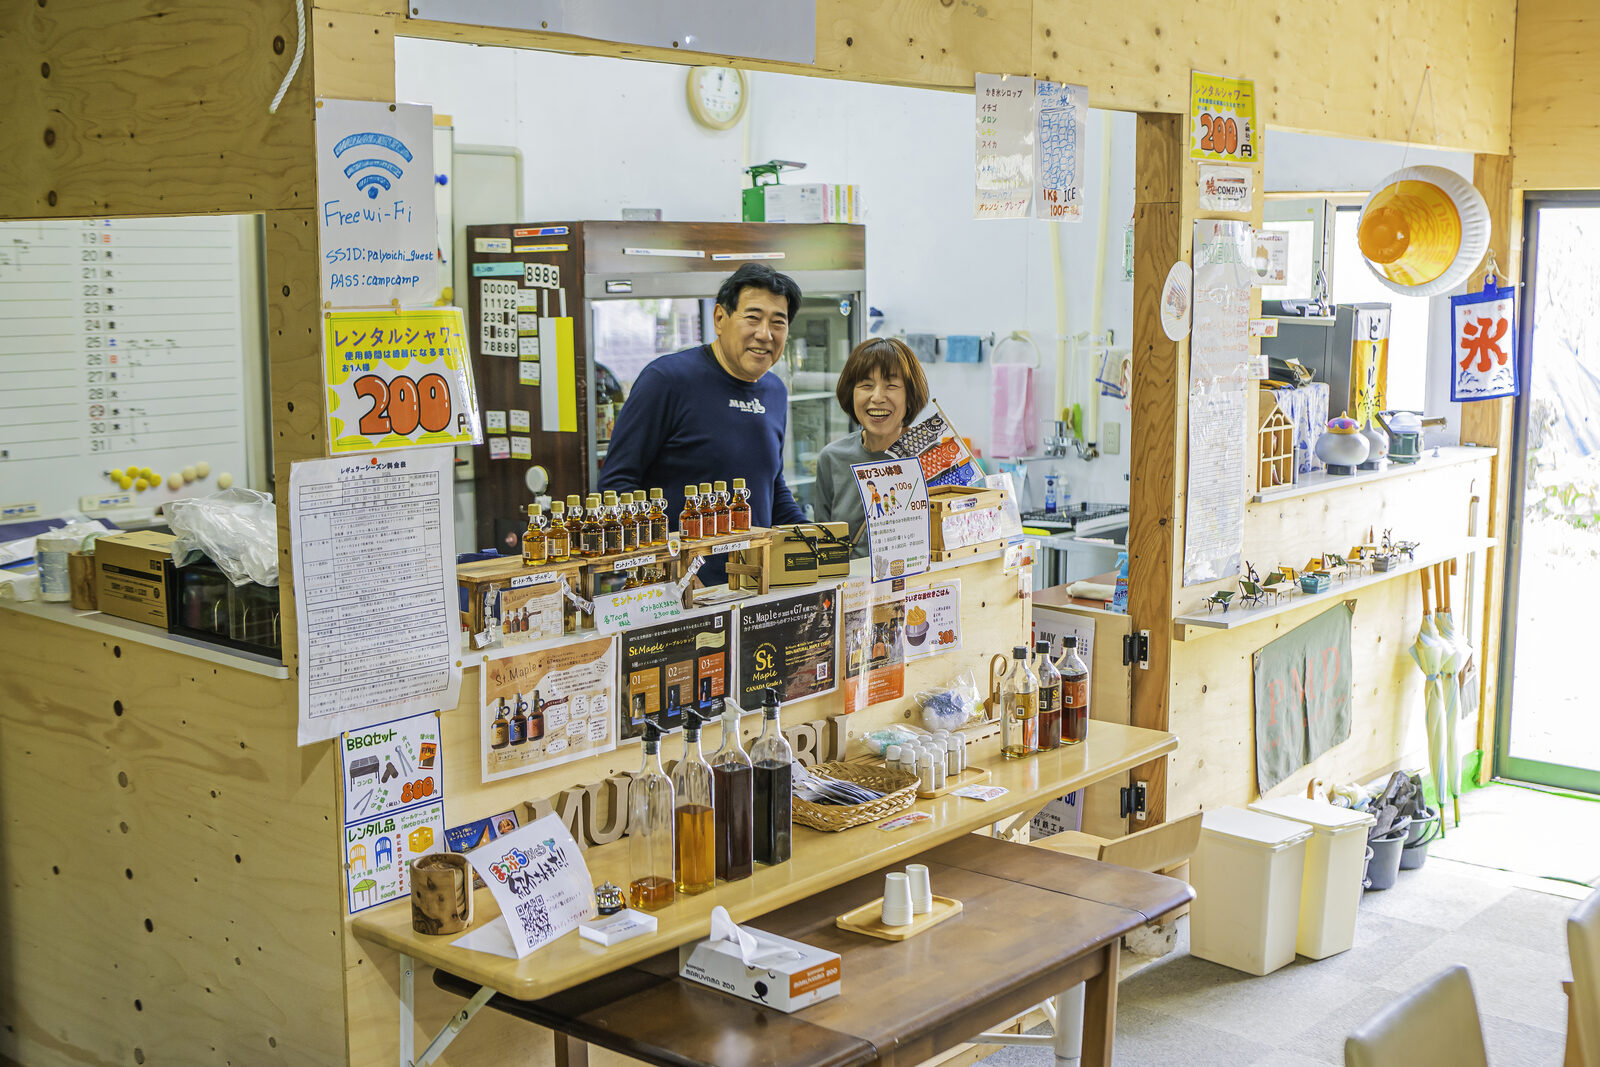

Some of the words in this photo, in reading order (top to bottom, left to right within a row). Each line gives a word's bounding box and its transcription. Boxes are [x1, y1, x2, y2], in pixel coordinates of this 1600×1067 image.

[985, 88, 1023, 98] かき氷シロップ
[981, 103, 998, 112] イチゴ
[981, 115, 997, 124] メロン
[981, 128, 998, 137] レモン
[981, 140, 998, 149] スイカ
[1063, 186, 1076, 203] ICE
[324, 200, 361, 227] Free
[334, 326, 461, 347] レンタルシャワー
[1459, 316, 1509, 373] 氷
[755, 609, 778, 625] Maple
[1040, 631, 1057, 645] MAY
[701, 659, 711, 670] 03
[667, 666, 678, 678] 02
[752, 669, 778, 682] Maple
[631, 675, 641, 686] 01
[745, 683, 765, 693] CANADA
[346, 728, 398, 752] BBQセット
[421, 747, 436, 755] FIRE
[356, 778, 373, 787] コンロ
[348, 818, 396, 843] レンタル品
[685, 968, 720, 985] MARUYAMA
[721, 981, 736, 992] ZOO
